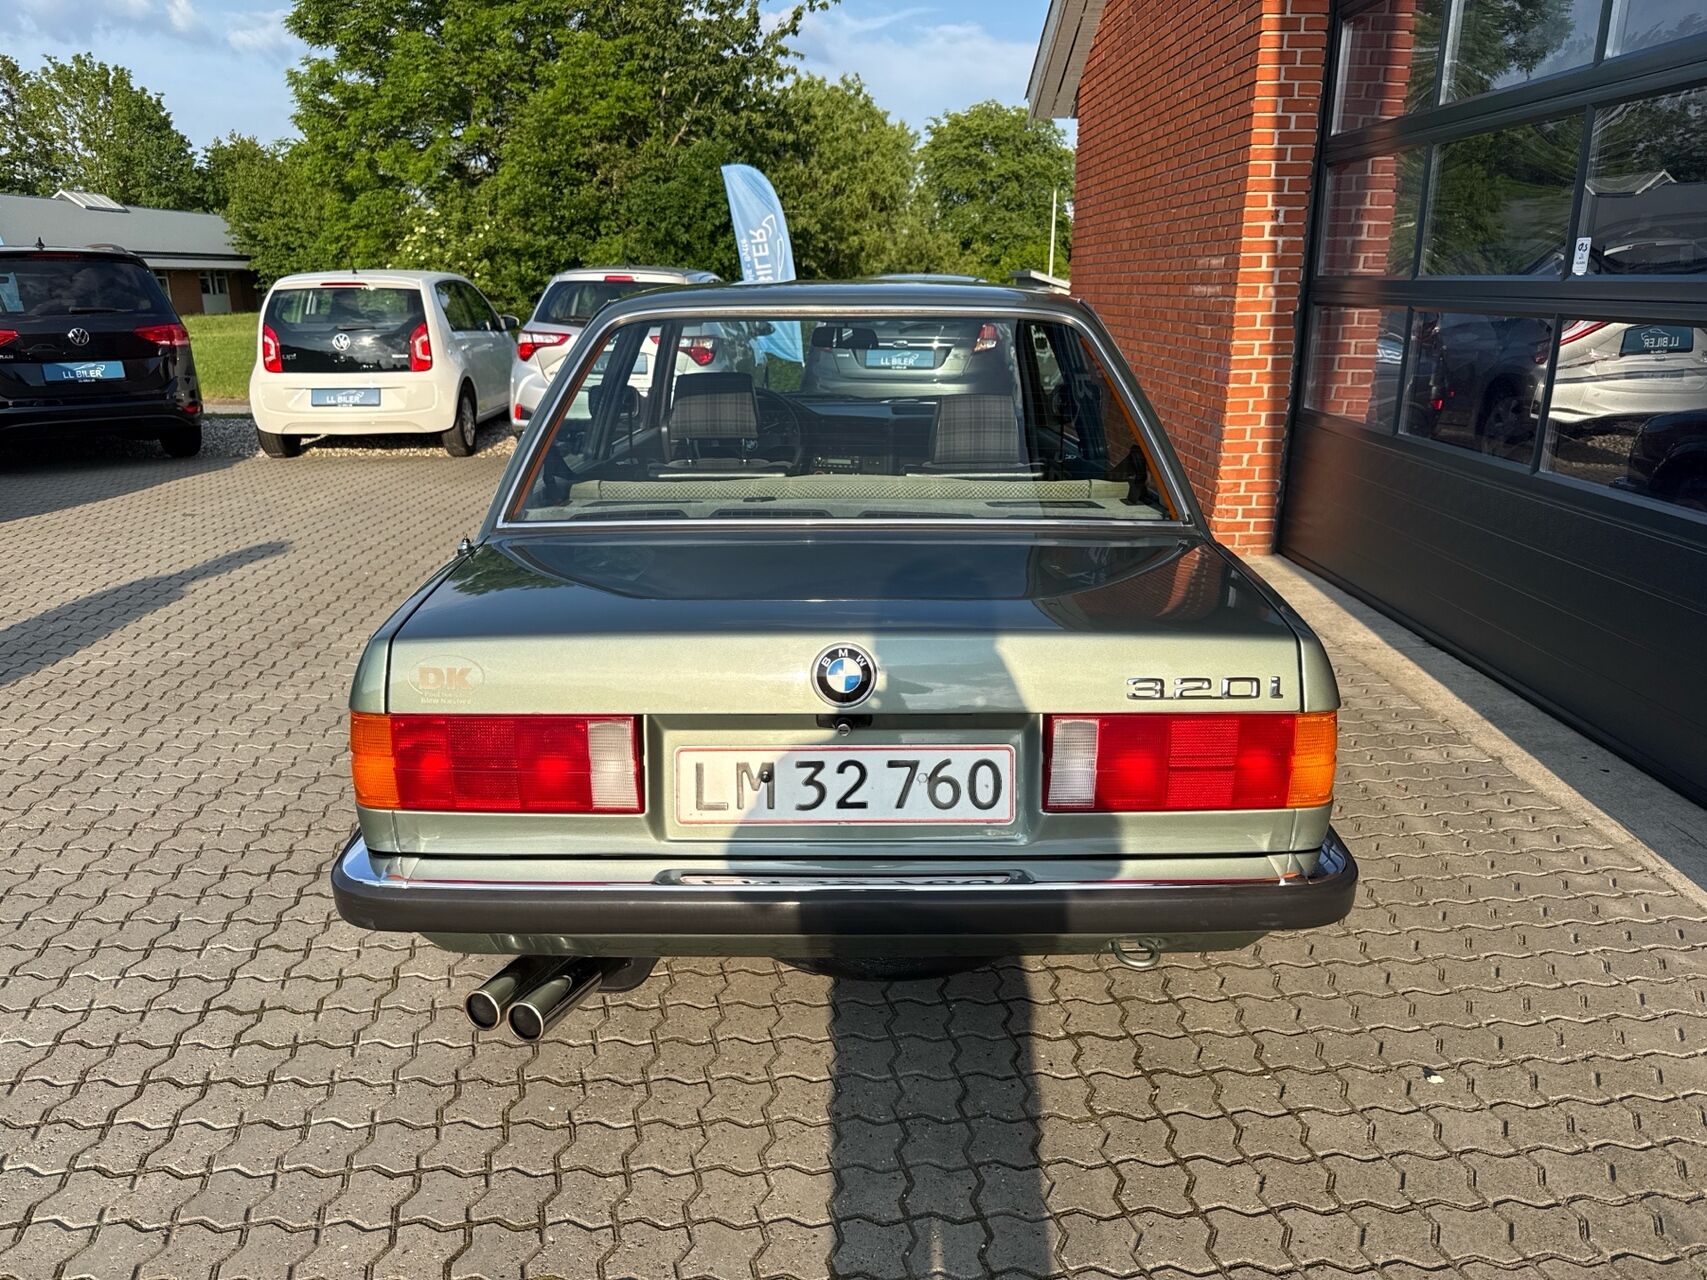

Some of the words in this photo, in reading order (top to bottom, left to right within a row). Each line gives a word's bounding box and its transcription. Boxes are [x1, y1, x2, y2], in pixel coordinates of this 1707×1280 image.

[881, 357, 891, 366] LL
[891, 357, 915, 366] BILER
[62, 371, 75, 379] LL
[76, 369, 103, 378] BILER
[326, 396, 337, 404] LL
[337, 395, 361, 404] BILER
[821, 648, 868, 668] BMW
[418, 667, 473, 690] DK
[1126, 675, 1284, 701] 320i
[695, 761, 776, 811] LM
[795, 759, 869, 811] 32
[886, 758, 1004, 811] 760
